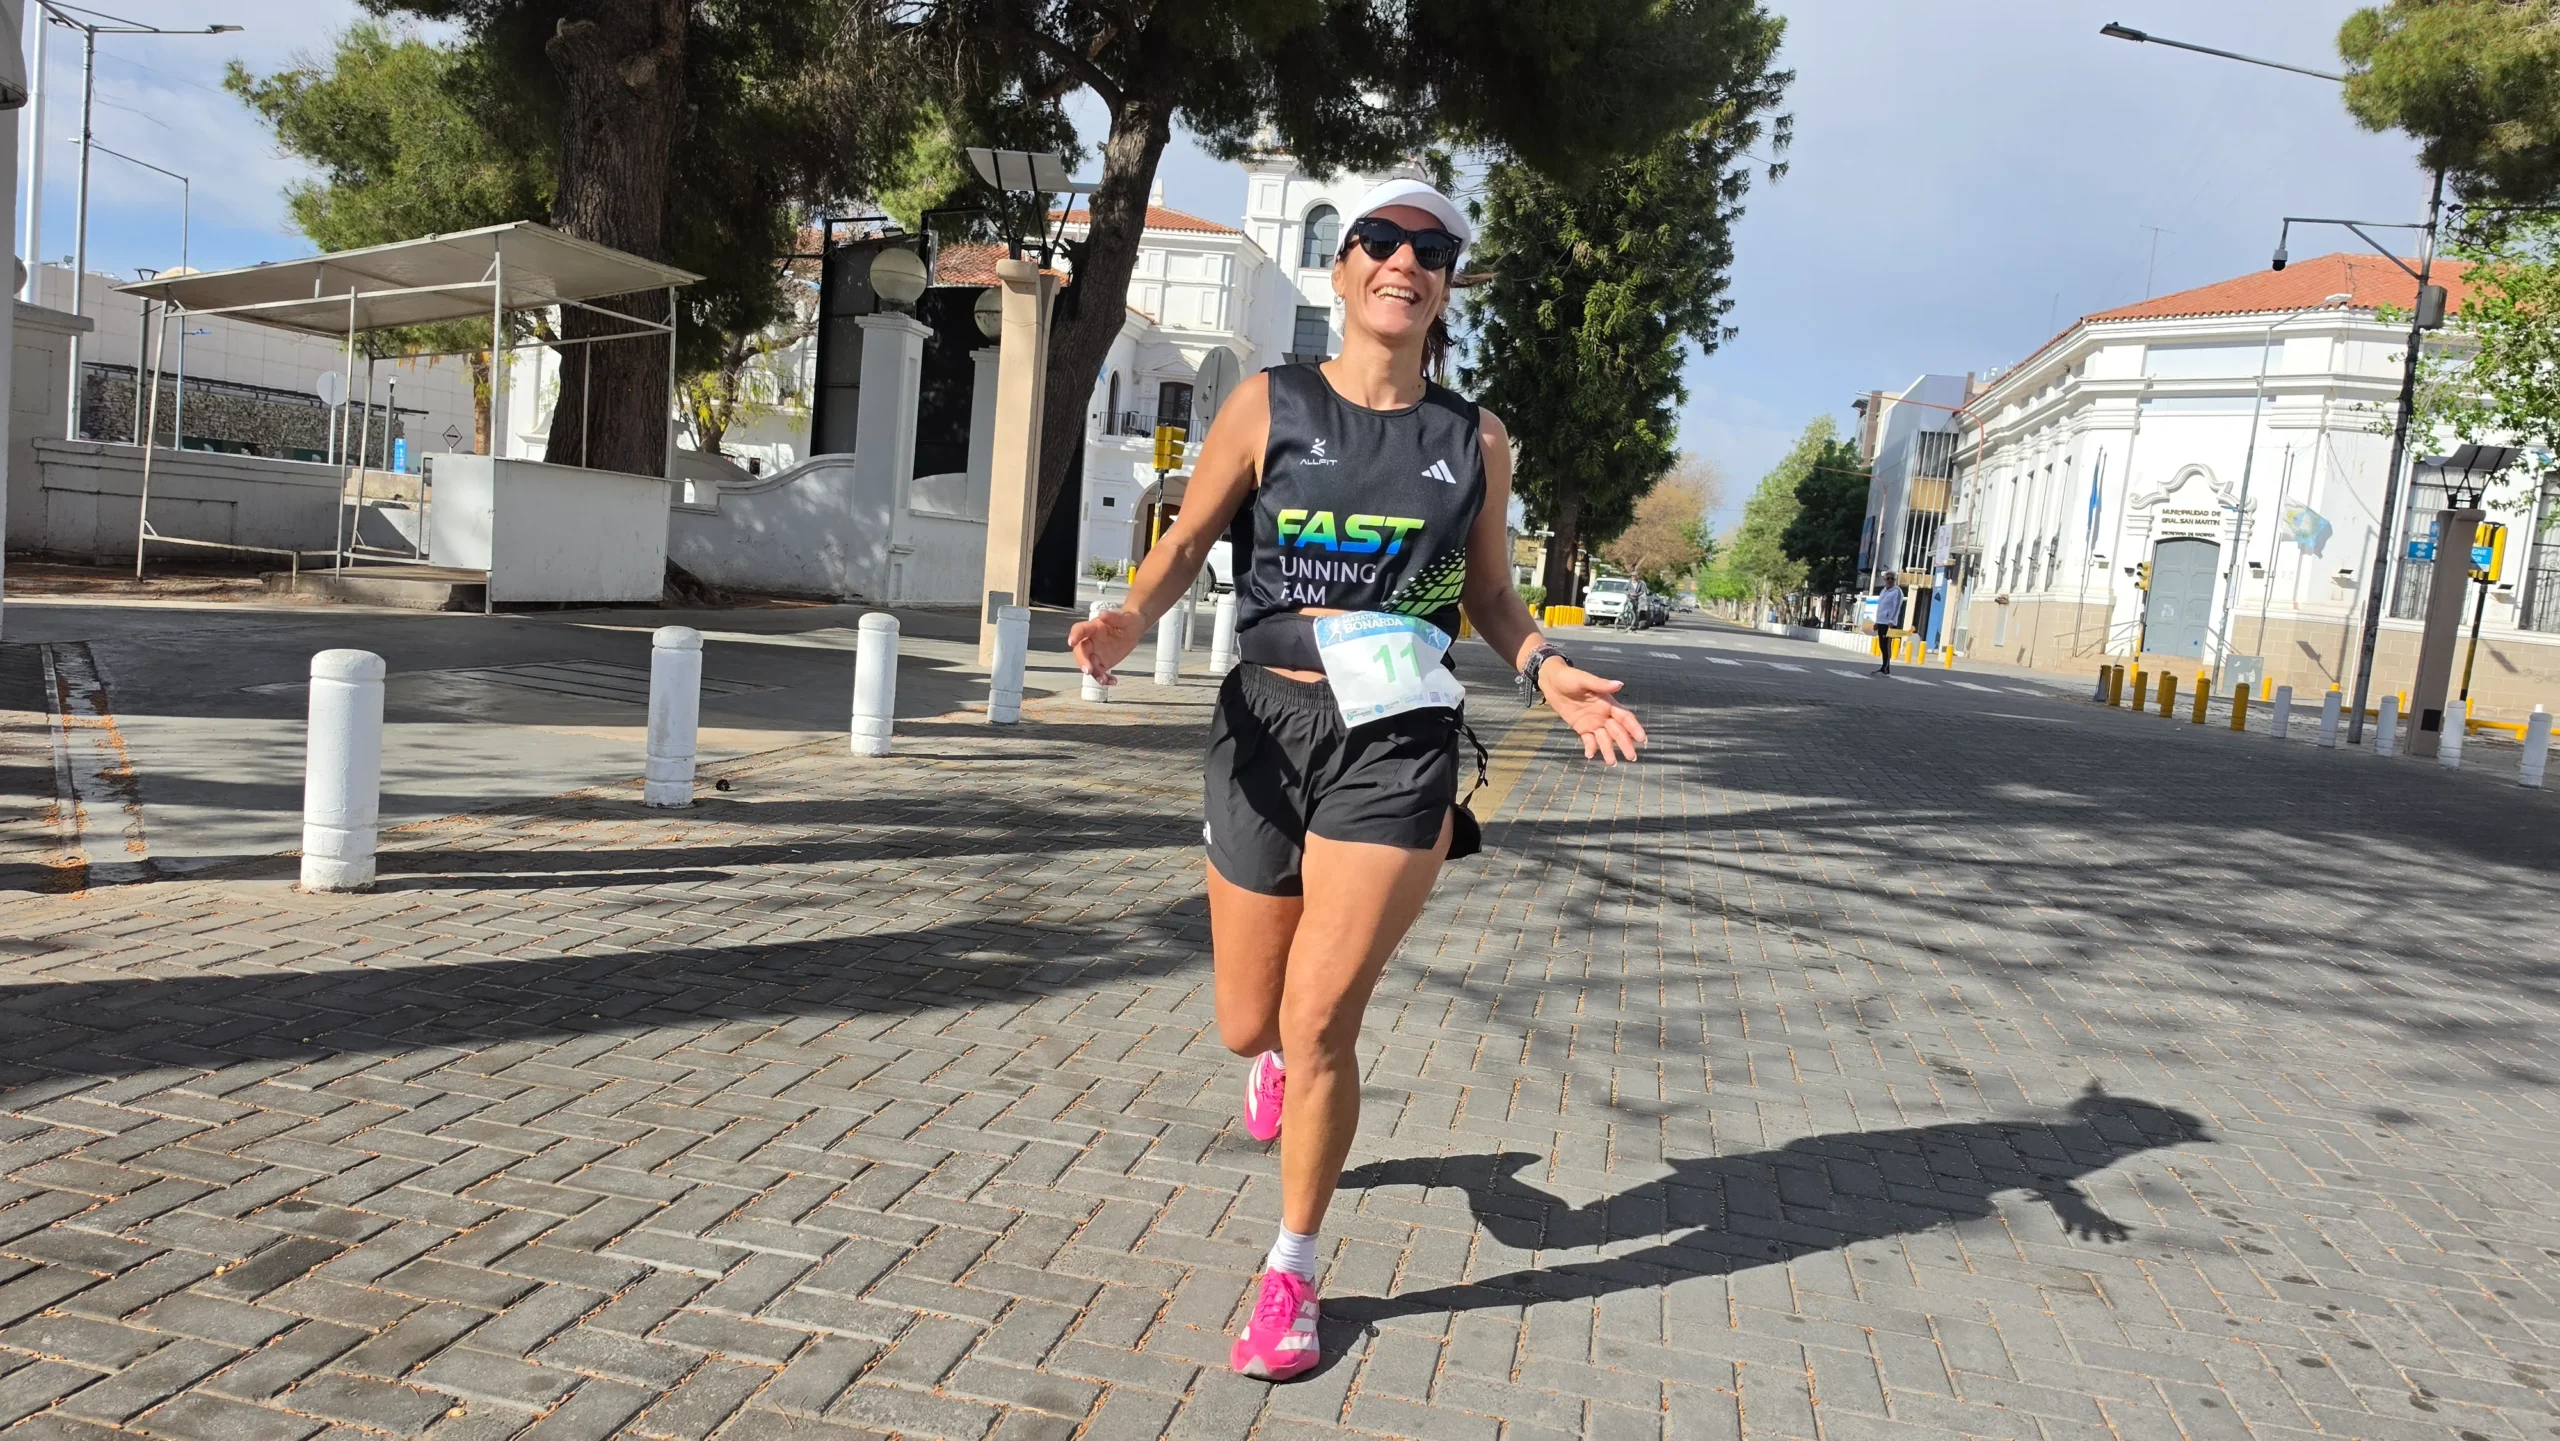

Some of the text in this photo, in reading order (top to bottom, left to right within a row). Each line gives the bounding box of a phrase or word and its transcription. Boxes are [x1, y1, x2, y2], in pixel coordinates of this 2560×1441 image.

[1300, 458, 1338, 466] ALLFIT
[1277, 509, 1425, 554] FAST
[1344, 617, 1404, 634] BONARDA
[1372, 642, 1421, 684] 11
